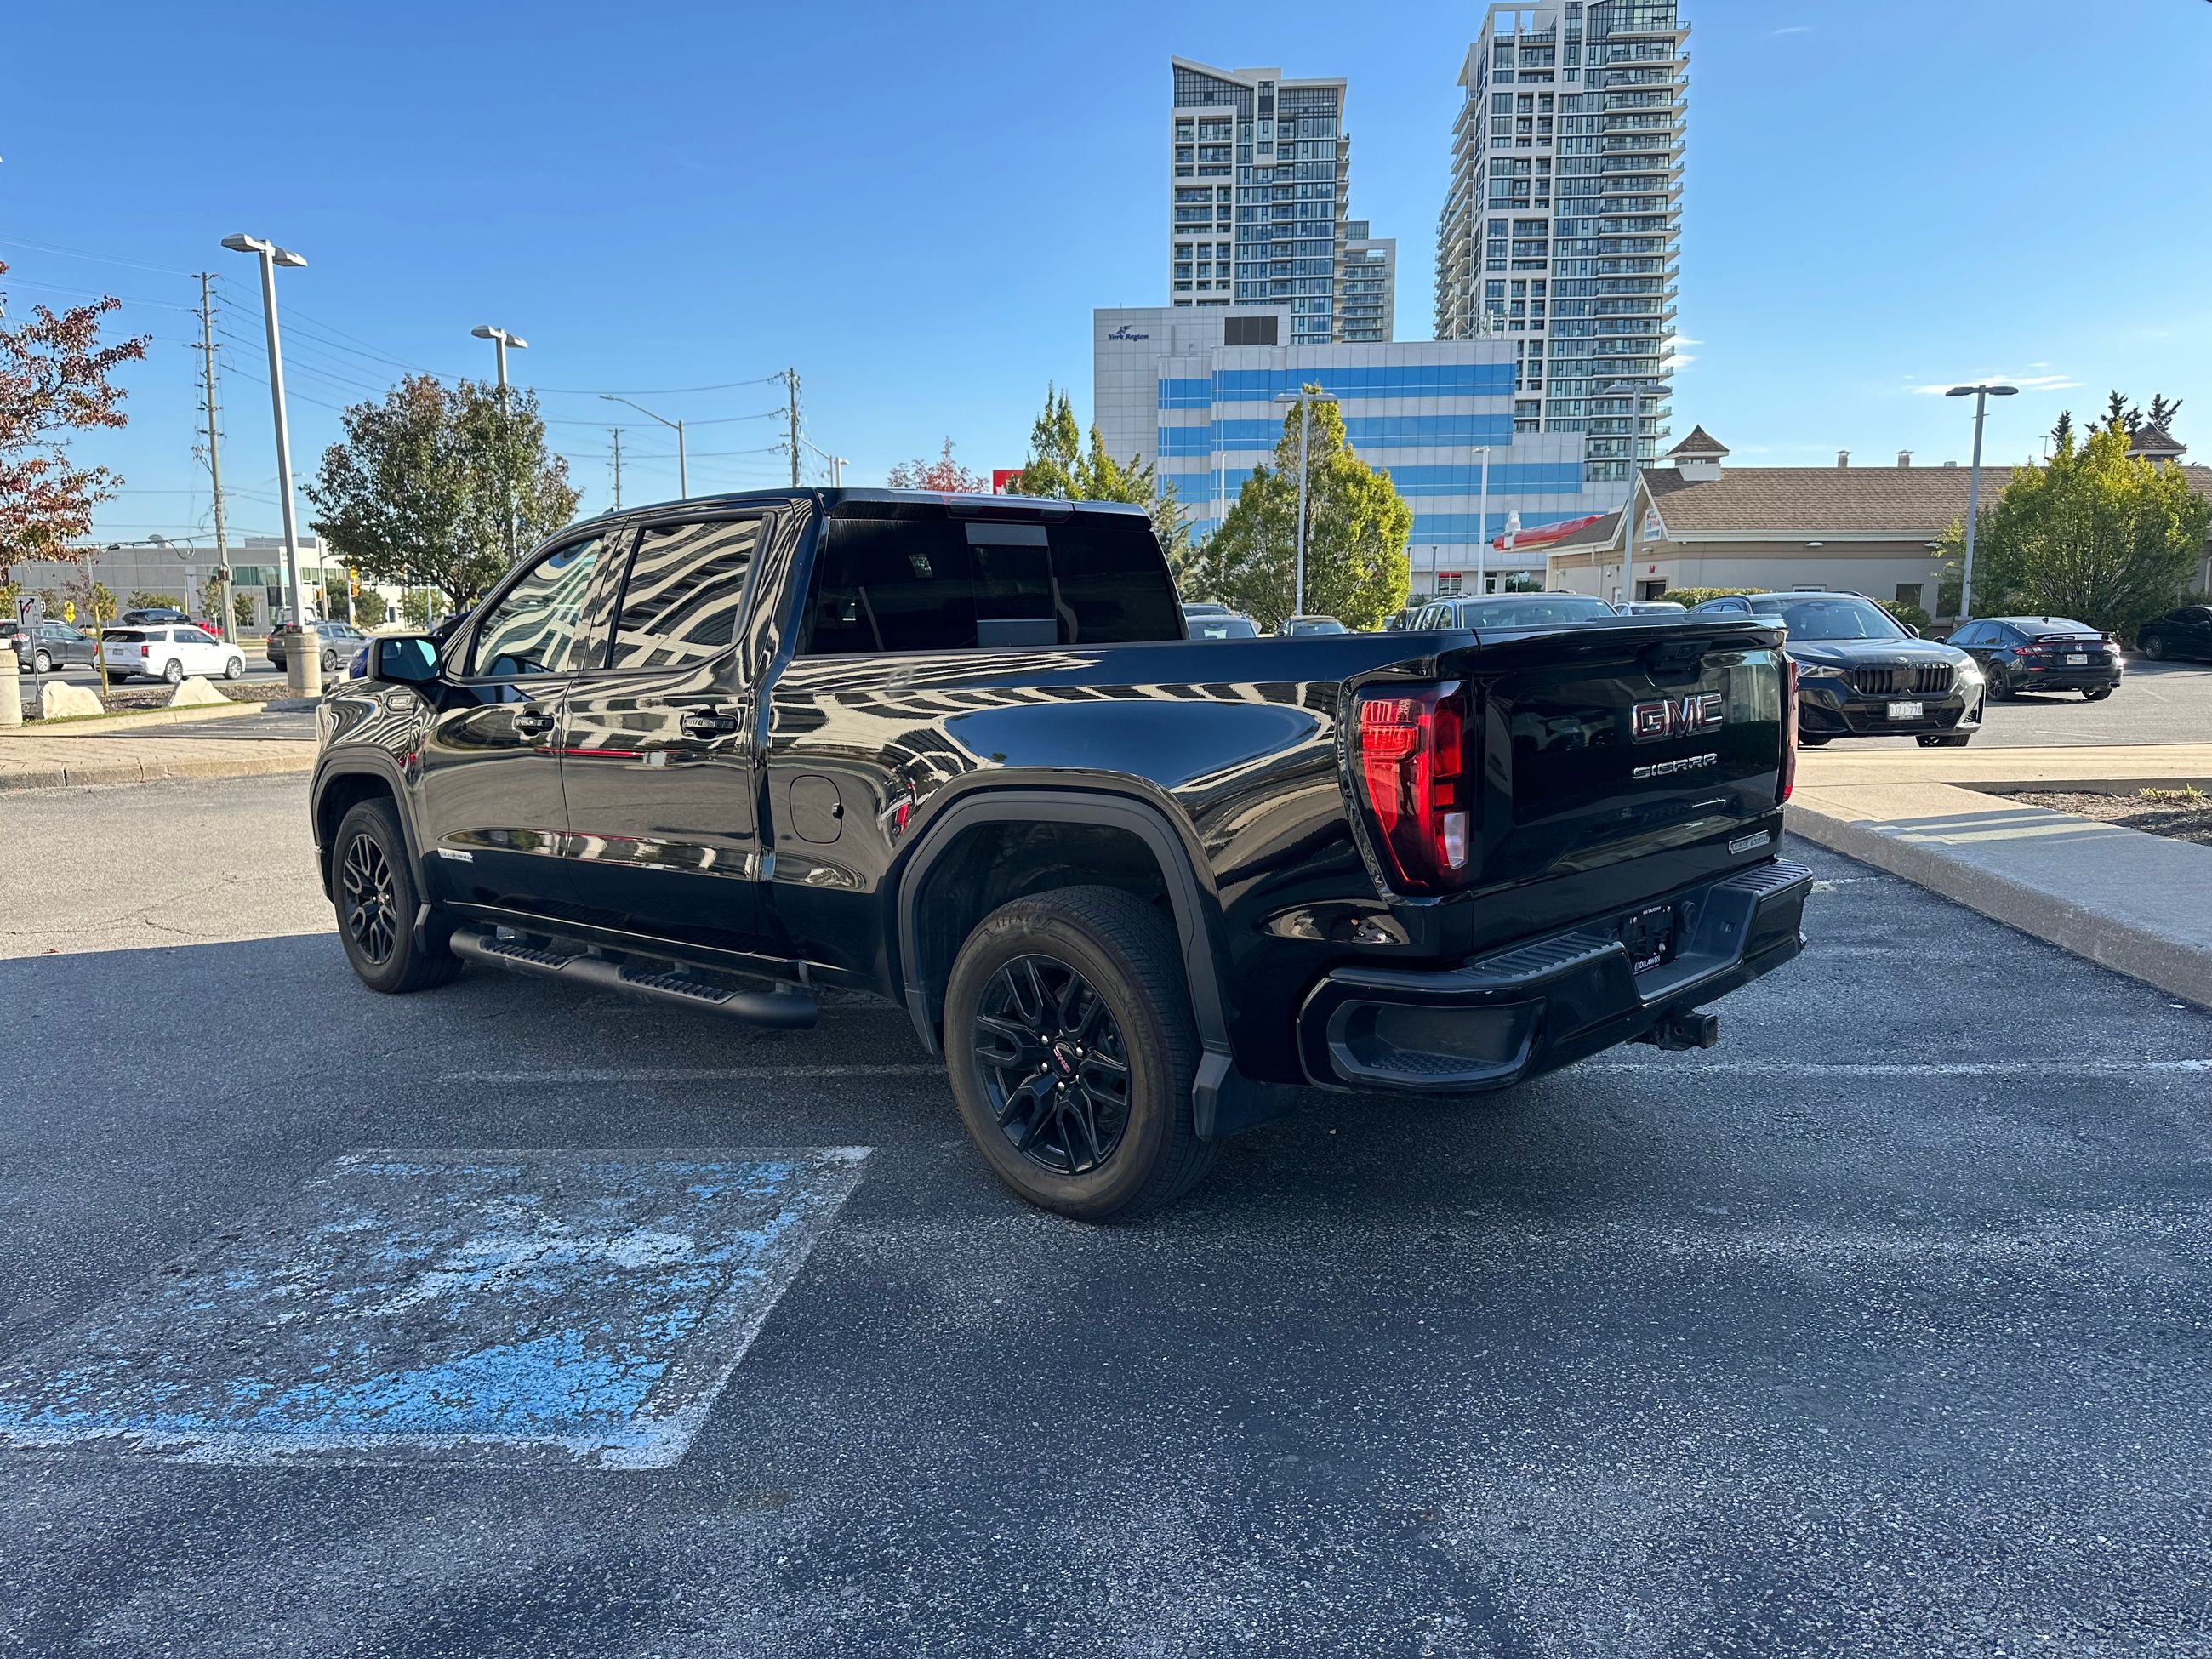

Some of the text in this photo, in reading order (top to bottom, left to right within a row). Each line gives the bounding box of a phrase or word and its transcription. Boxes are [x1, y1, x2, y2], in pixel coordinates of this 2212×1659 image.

[1631, 692, 1723, 745] GMC
[1633, 753, 1718, 779] SIERRA
[995, 914, 1040, 929] ALENZA
